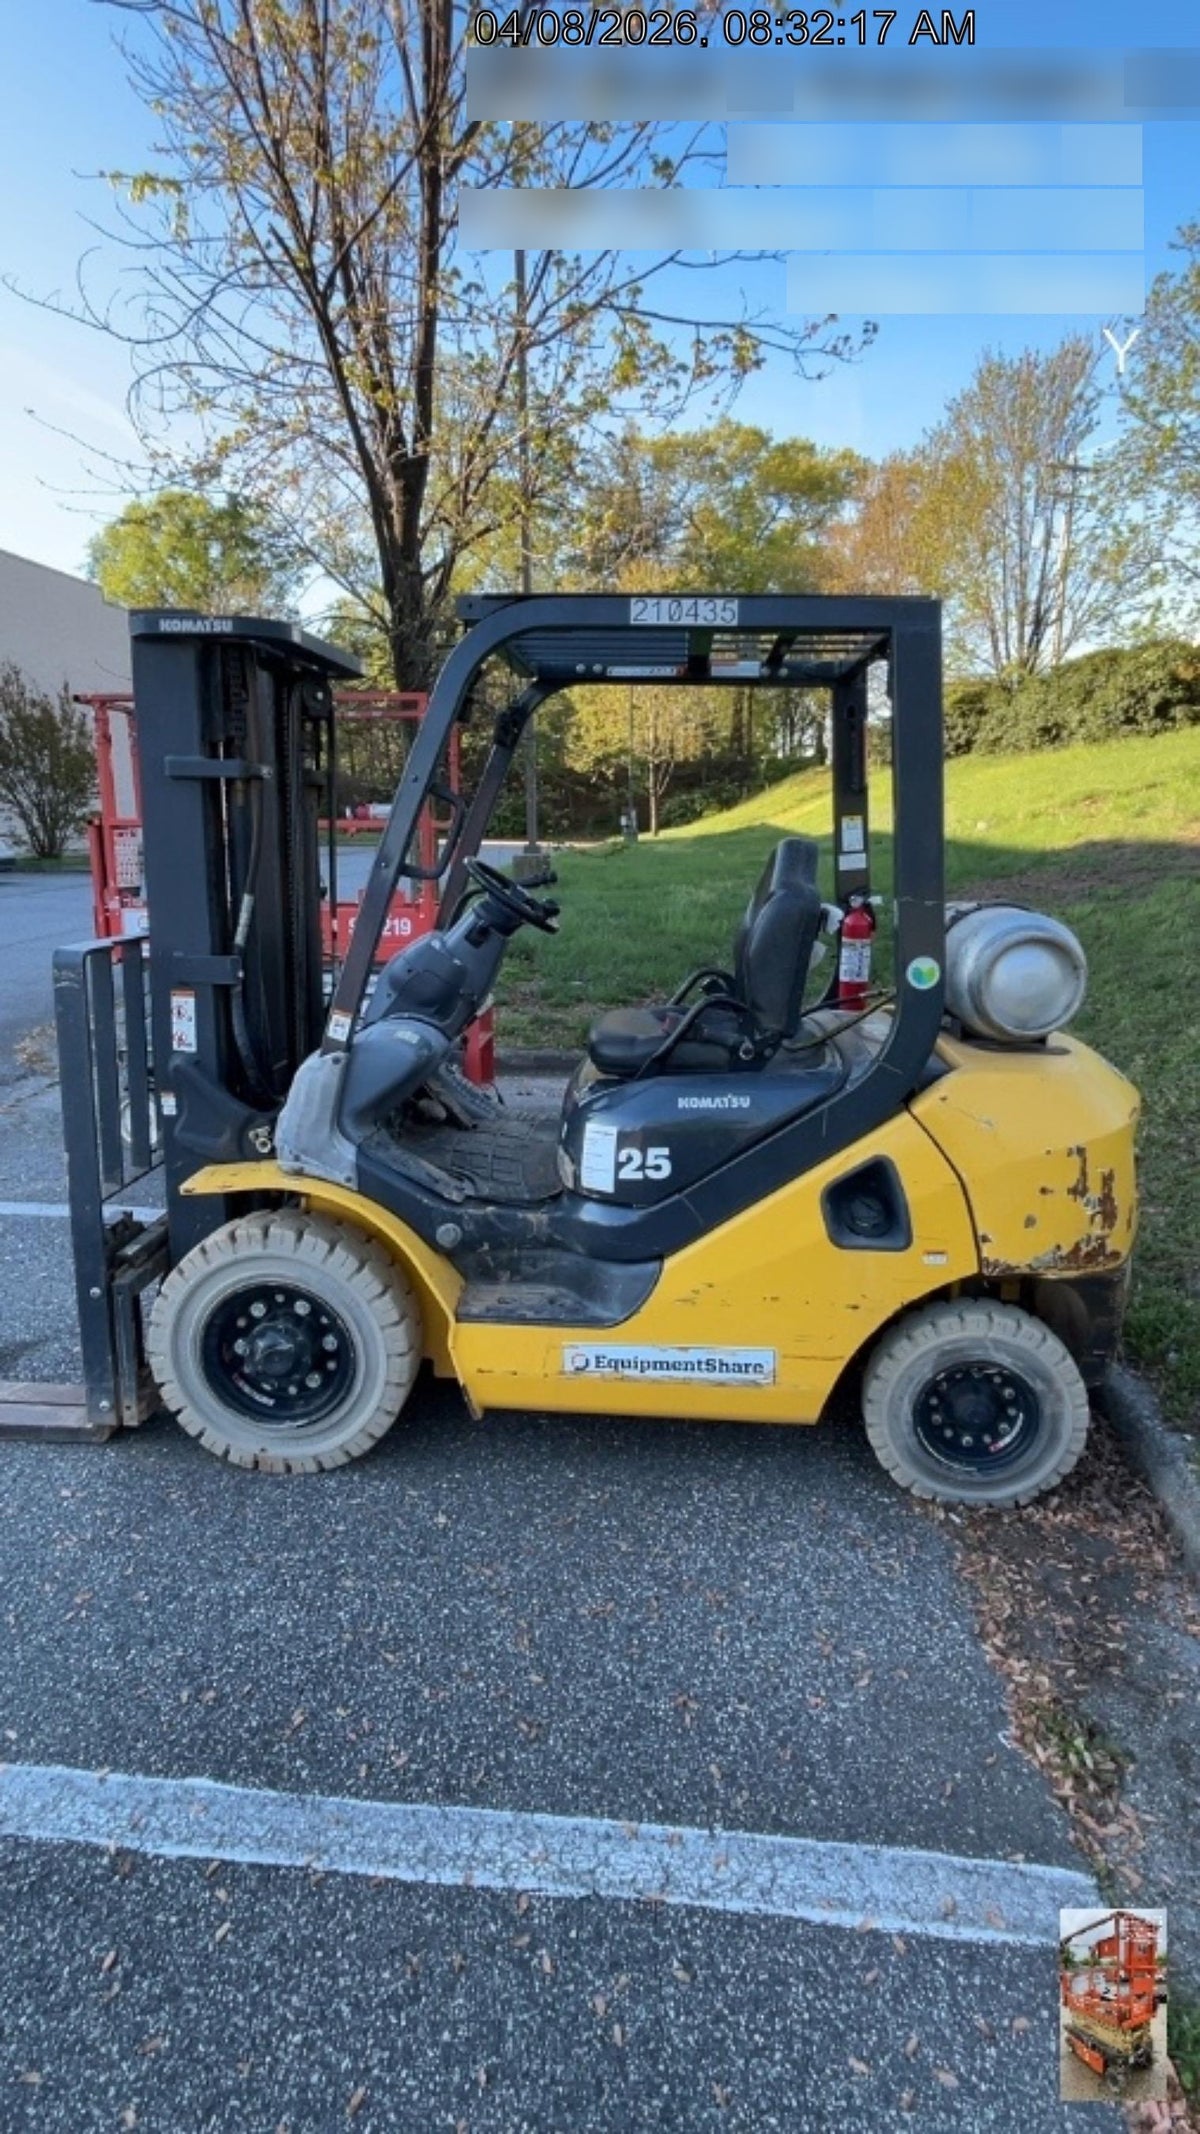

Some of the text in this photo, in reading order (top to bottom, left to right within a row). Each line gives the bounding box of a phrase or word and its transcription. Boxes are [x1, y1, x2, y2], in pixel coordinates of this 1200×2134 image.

[632, 600, 737, 624] 210435
[159, 617, 233, 633] KOMATSU
[677, 1093, 751, 1109] KOMATSU
[618, 1146, 672, 1180] 25
[594, 1354, 765, 1375] EquipmentShare
